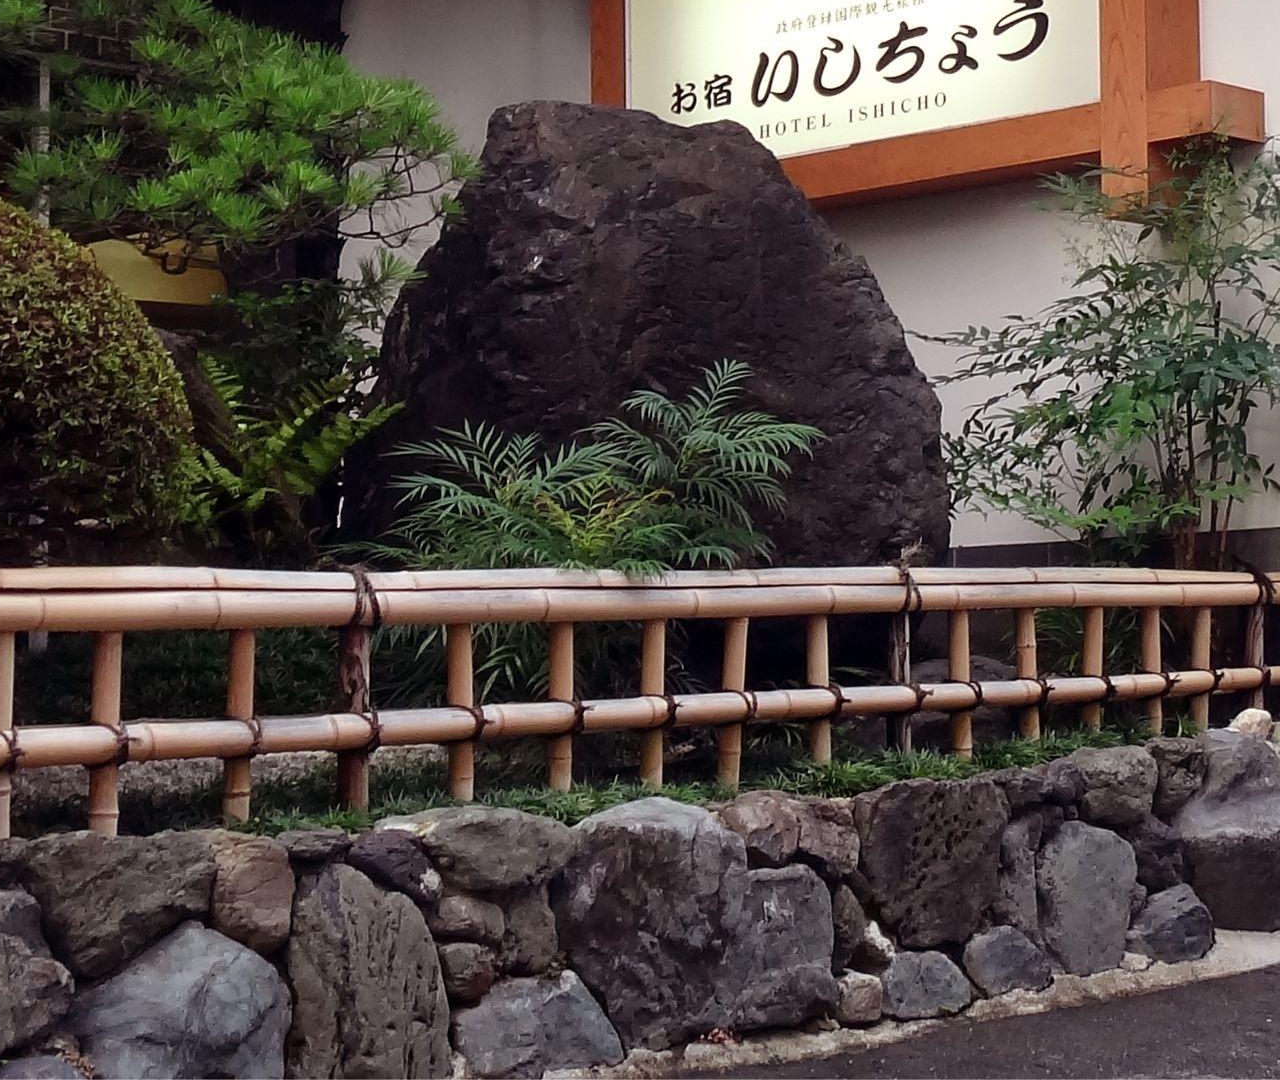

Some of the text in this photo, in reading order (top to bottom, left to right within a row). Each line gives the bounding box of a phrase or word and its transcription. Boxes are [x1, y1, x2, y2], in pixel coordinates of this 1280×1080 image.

[669, 73, 734, 114] お宿
[759, 91, 949, 140] HOTEL ISHICHO
